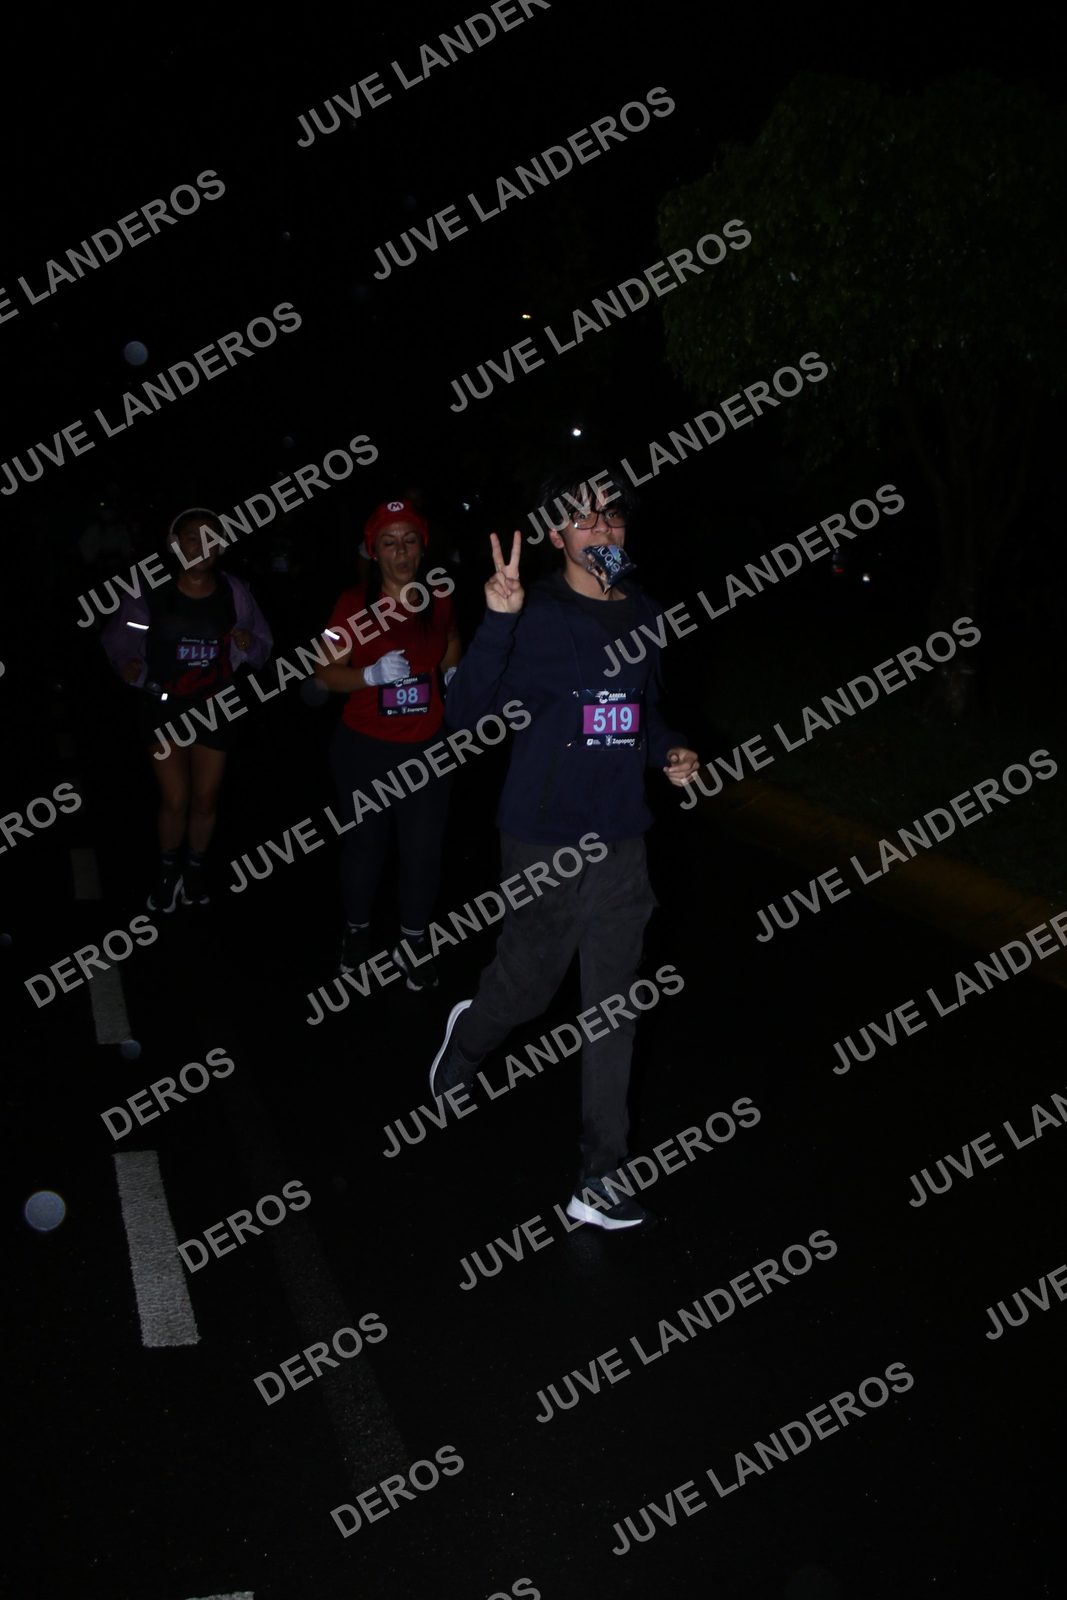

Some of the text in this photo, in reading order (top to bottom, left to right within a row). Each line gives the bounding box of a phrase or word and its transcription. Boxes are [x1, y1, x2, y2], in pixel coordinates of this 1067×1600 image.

[178, 645, 216, 660] 1114
[396, 687, 418, 705] 98
[593, 706, 632, 732] 519
